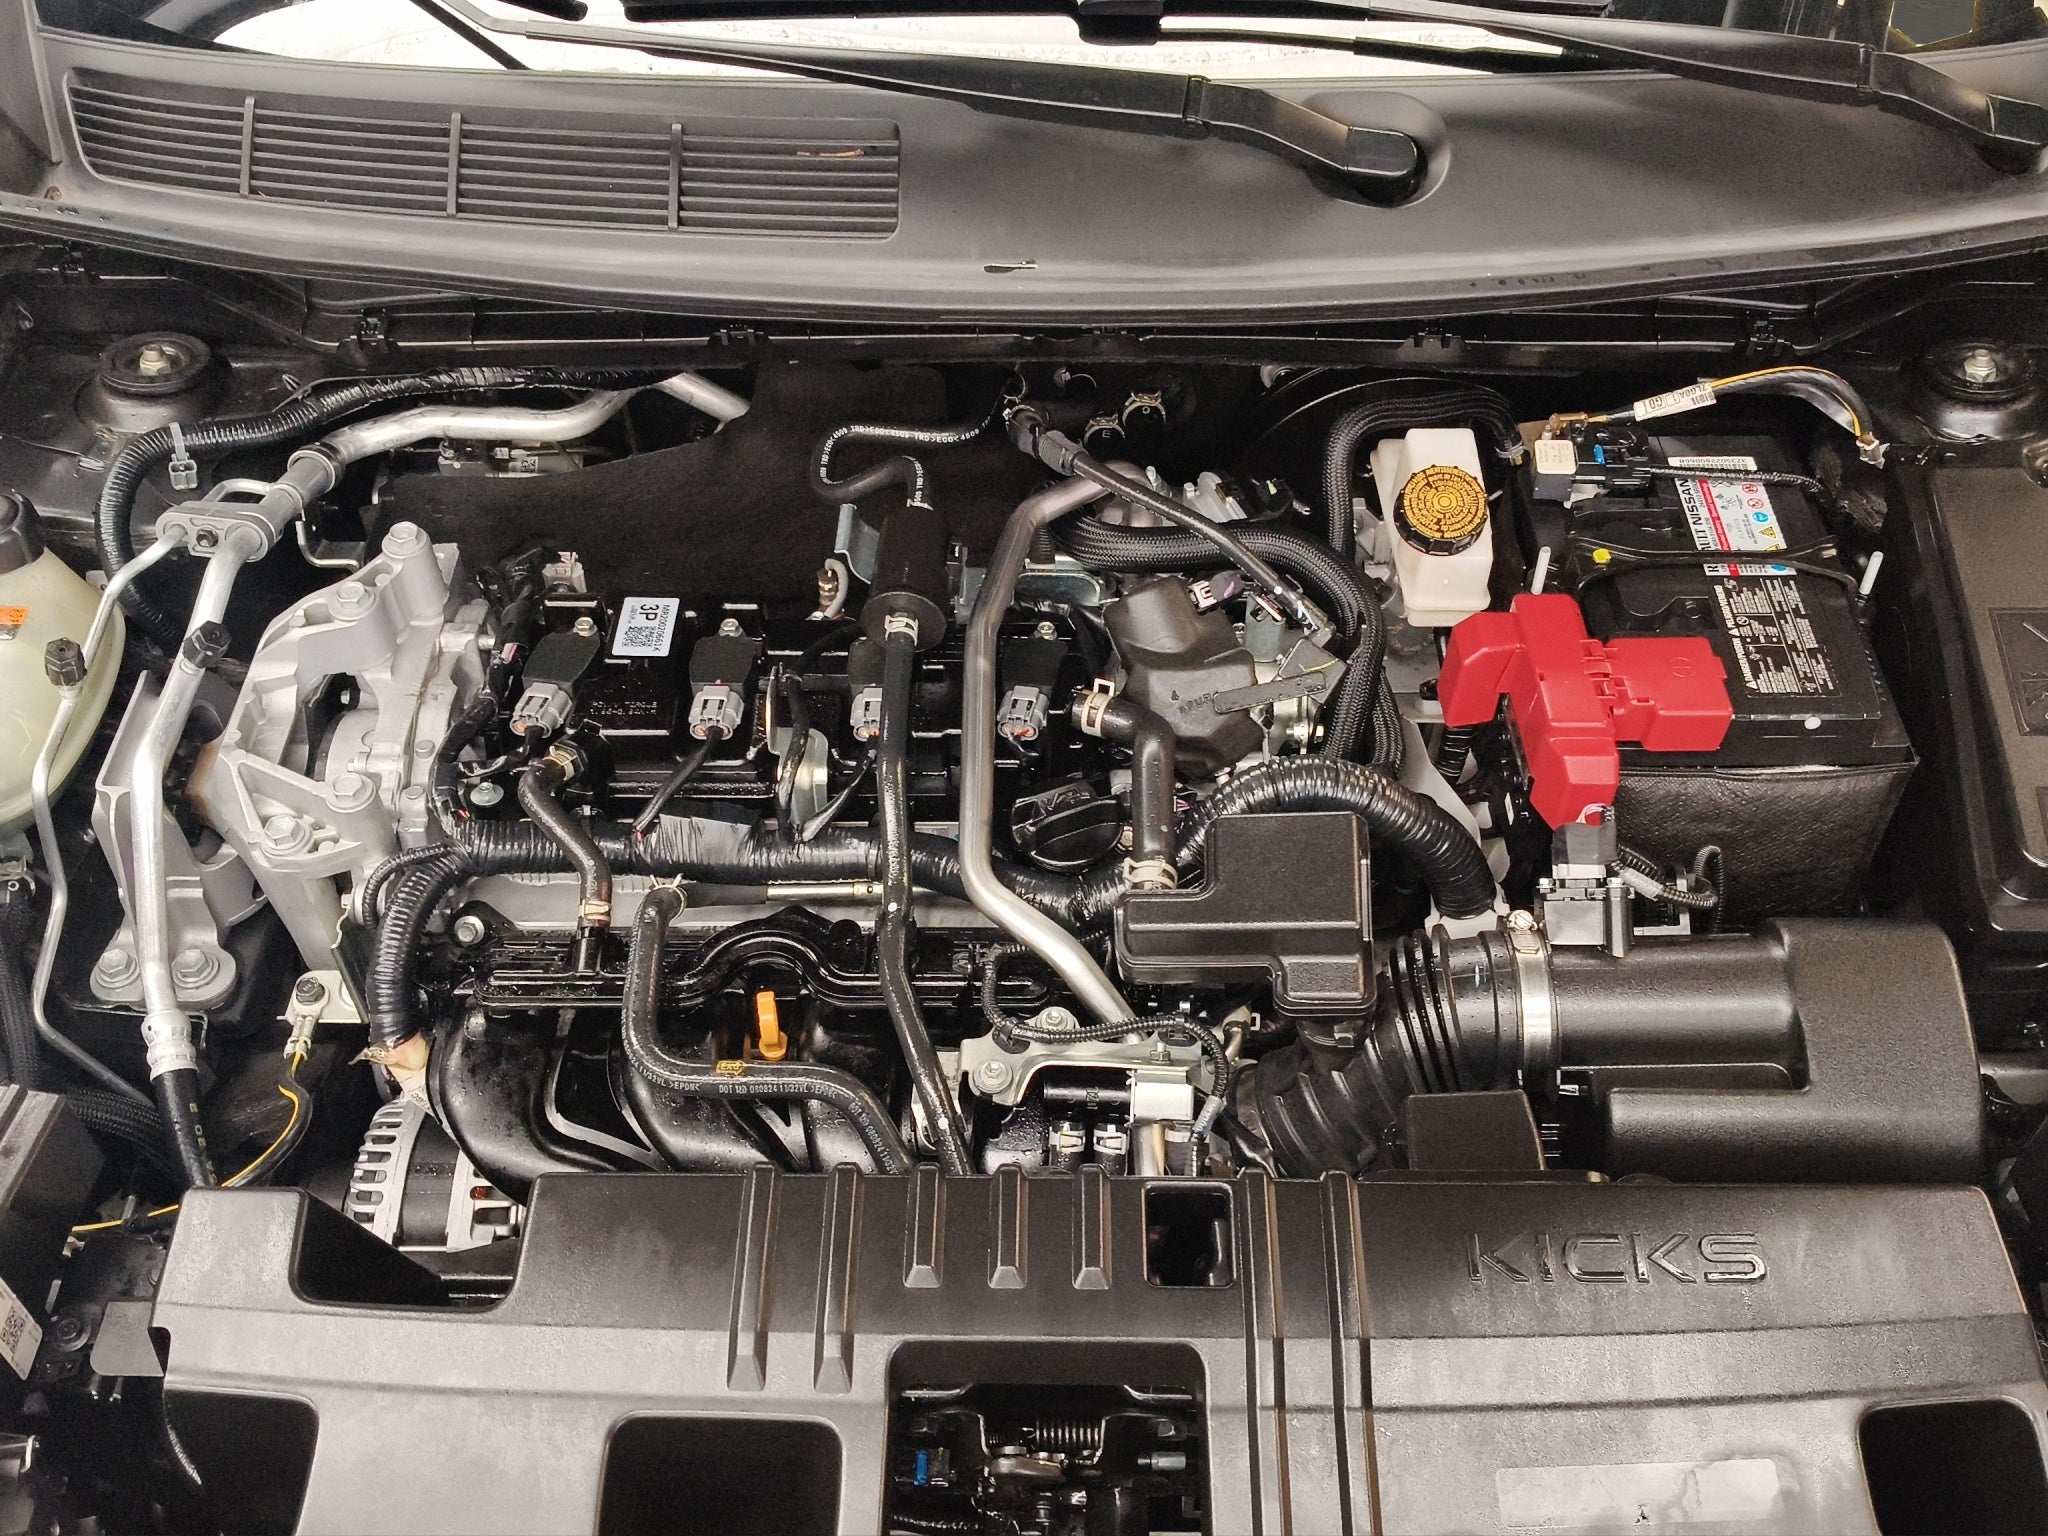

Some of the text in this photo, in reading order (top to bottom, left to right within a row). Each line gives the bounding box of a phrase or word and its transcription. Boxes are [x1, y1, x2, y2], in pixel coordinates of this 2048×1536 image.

[1678, 479, 1703, 525] NISSAN
[639, 603, 660, 621] 3P
[1467, 1232, 1768, 1284] KICKS
